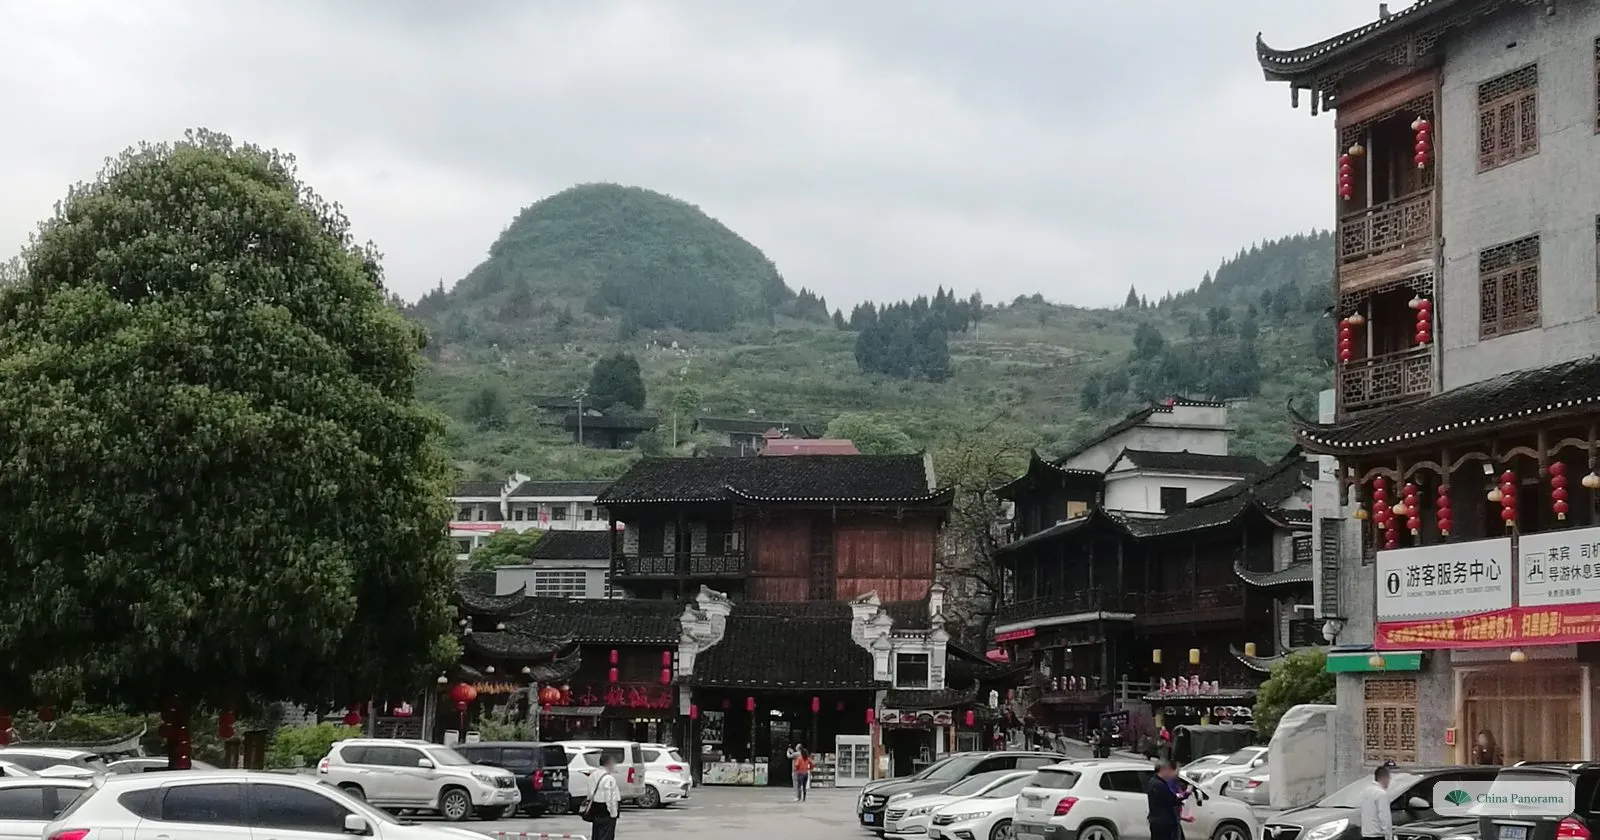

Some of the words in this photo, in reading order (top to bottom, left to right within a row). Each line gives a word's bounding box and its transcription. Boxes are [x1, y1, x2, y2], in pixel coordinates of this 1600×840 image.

[1548, 546, 1570, 562] 来宾
[1406, 558, 1502, 587] 游客服务中心
